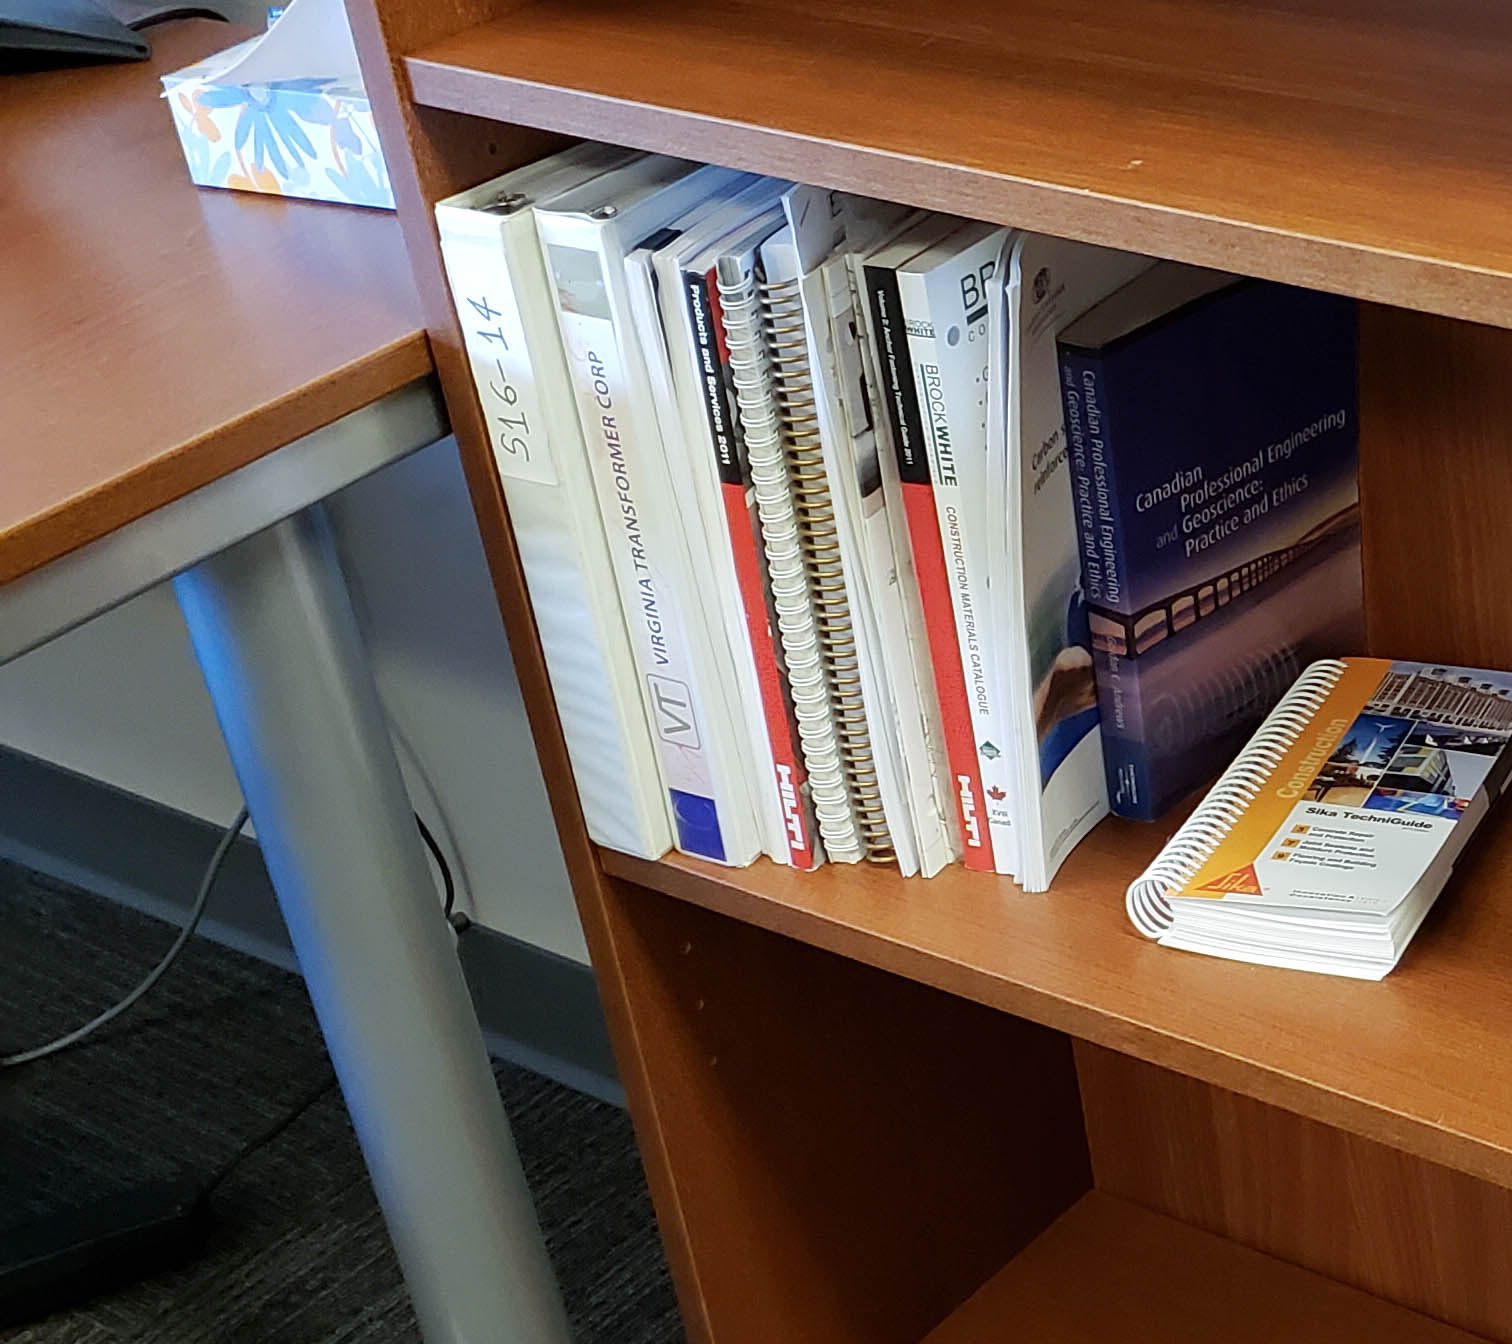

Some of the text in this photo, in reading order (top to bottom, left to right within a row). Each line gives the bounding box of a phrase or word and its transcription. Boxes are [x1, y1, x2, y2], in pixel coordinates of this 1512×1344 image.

[690, 284, 731, 465] Products and Services 2011
[1083, 369, 1121, 604] Canadian Professional Engineering
[1136, 466, 1203, 513] Canadian
[1180, 409, 1347, 513] Professional Engineering
[587, 351, 669, 665] VIRGINIA TRANSFORMER CORP
[1077, 476, 1094, 528] Practice
[1155, 479, 1264, 550] and Geoscience:
[1184, 473, 1310, 557] Practice and Ethics
[1083, 532, 1097, 558] and
[1086, 559, 1102, 599] Ethics
[945, 506, 990, 716] CONSTRUCTION MATERIALS CATALOGUE
[654, 682, 693, 736] VT
[1275, 717, 1349, 800] Construction
[775, 763, 806, 851] HILTI
[957, 774, 982, 848] HILTI
[1305, 806, 1434, 830] Sika TechniGuide
[1206, 872, 1258, 894] Sika
